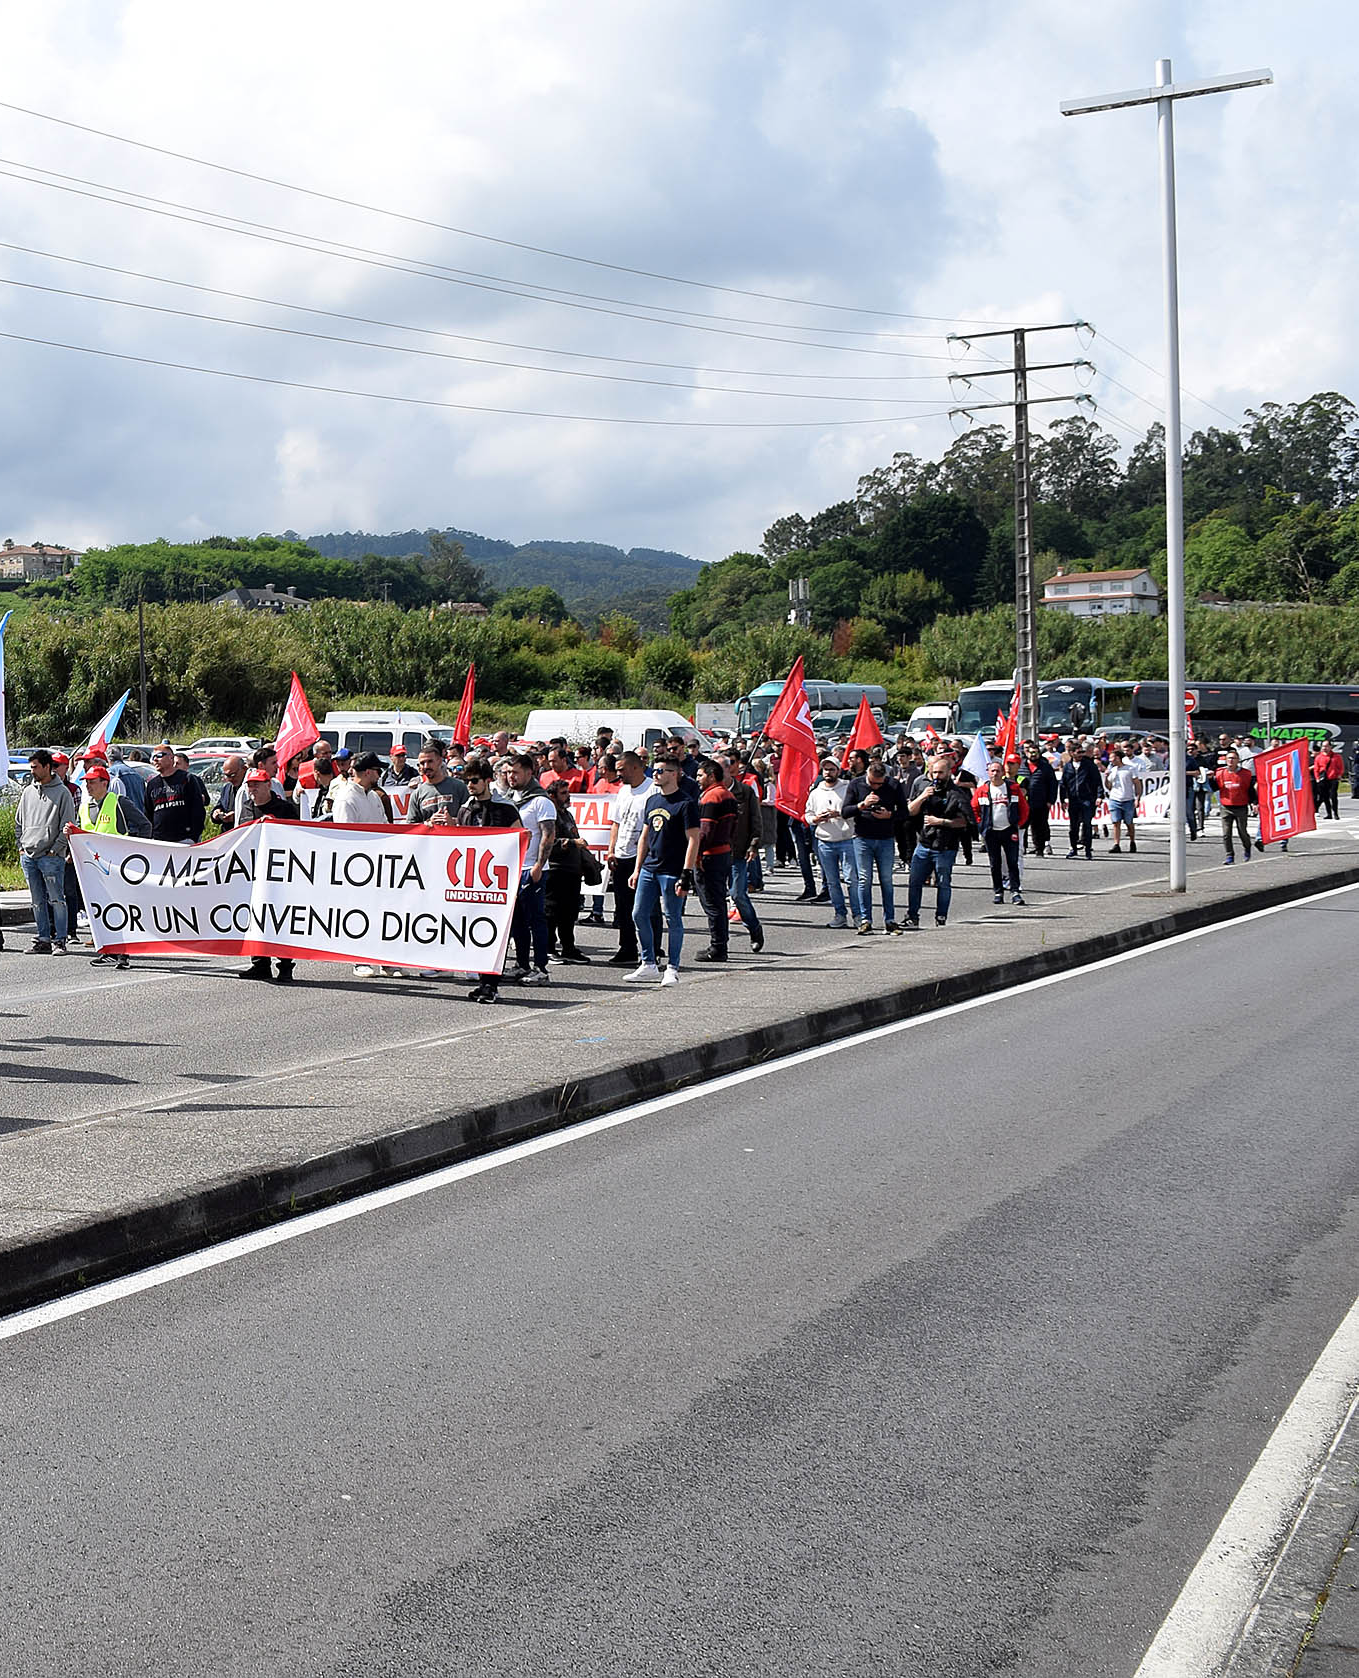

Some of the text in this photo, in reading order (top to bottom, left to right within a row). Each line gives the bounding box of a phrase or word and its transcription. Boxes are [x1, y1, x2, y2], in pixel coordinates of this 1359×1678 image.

[1250, 727, 1328, 740] ALVAREZ
[571, 802, 614, 825] TAL
[1271, 760, 1293, 833] CCOO
[120, 853, 150, 886] O
[266, 848, 316, 886] EN
[330, 851, 425, 890] LOITA
[446, 847, 509, 890] CIG
[446, 889, 507, 904] INDUSTRIA
[152, 905, 200, 935] UN
[209, 903, 370, 939] CONVENIO
[381, 911, 498, 948] DIGNO
